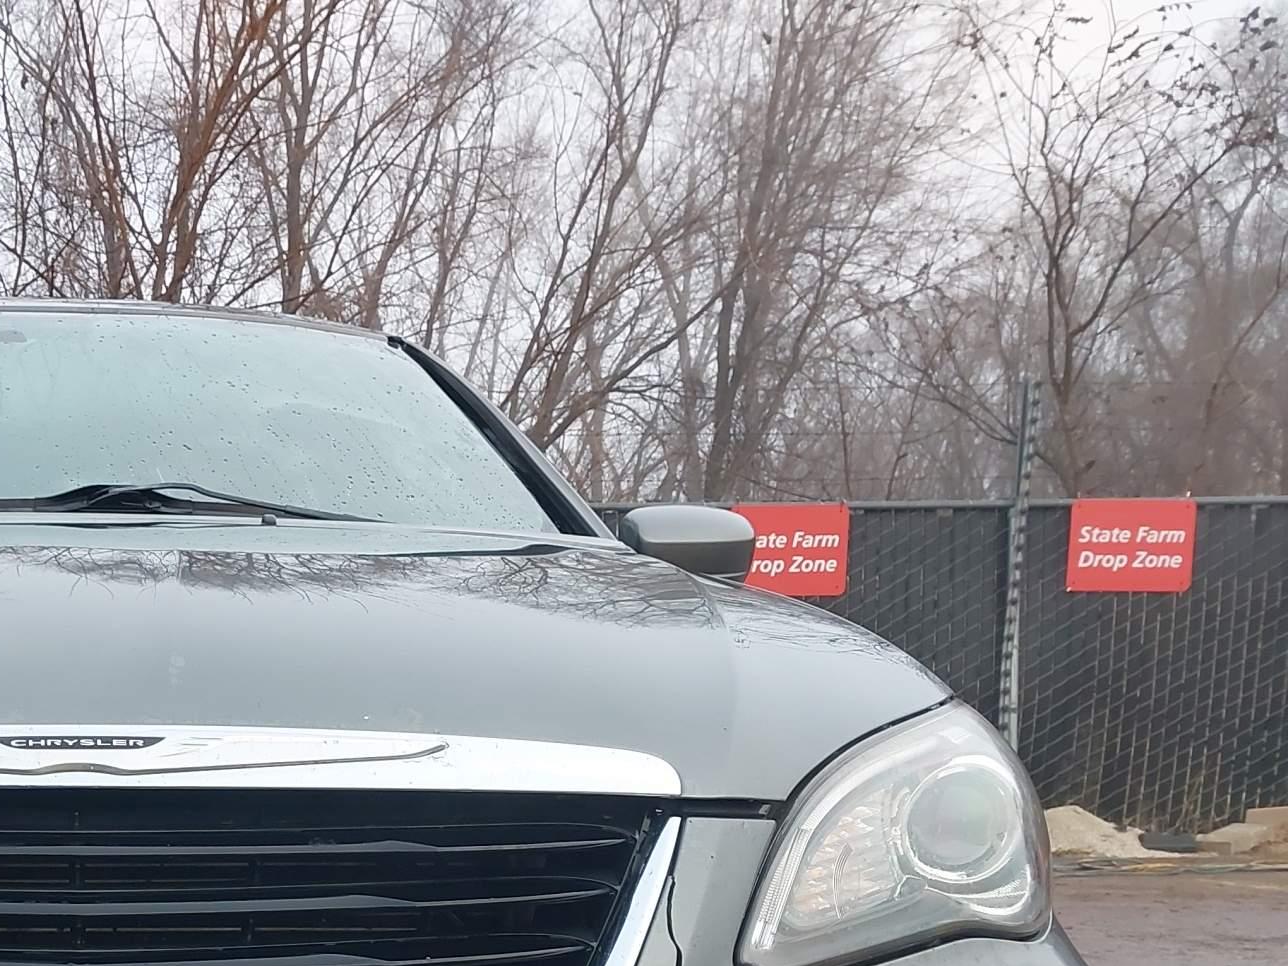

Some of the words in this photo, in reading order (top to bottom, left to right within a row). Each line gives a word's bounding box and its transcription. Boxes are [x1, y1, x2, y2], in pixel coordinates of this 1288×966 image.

[755, 532, 788, 549] ate
[792, 531, 840, 548] Farm
[1078, 525, 1132, 543] State
[1135, 526, 1186, 543] Farm
[751, 558, 785, 576] rop
[788, 555, 837, 573] Zone
[1078, 550, 1128, 572] Drop
[1131, 550, 1183, 568] Zone
[10, 738, 145, 748] CHRYSLER
